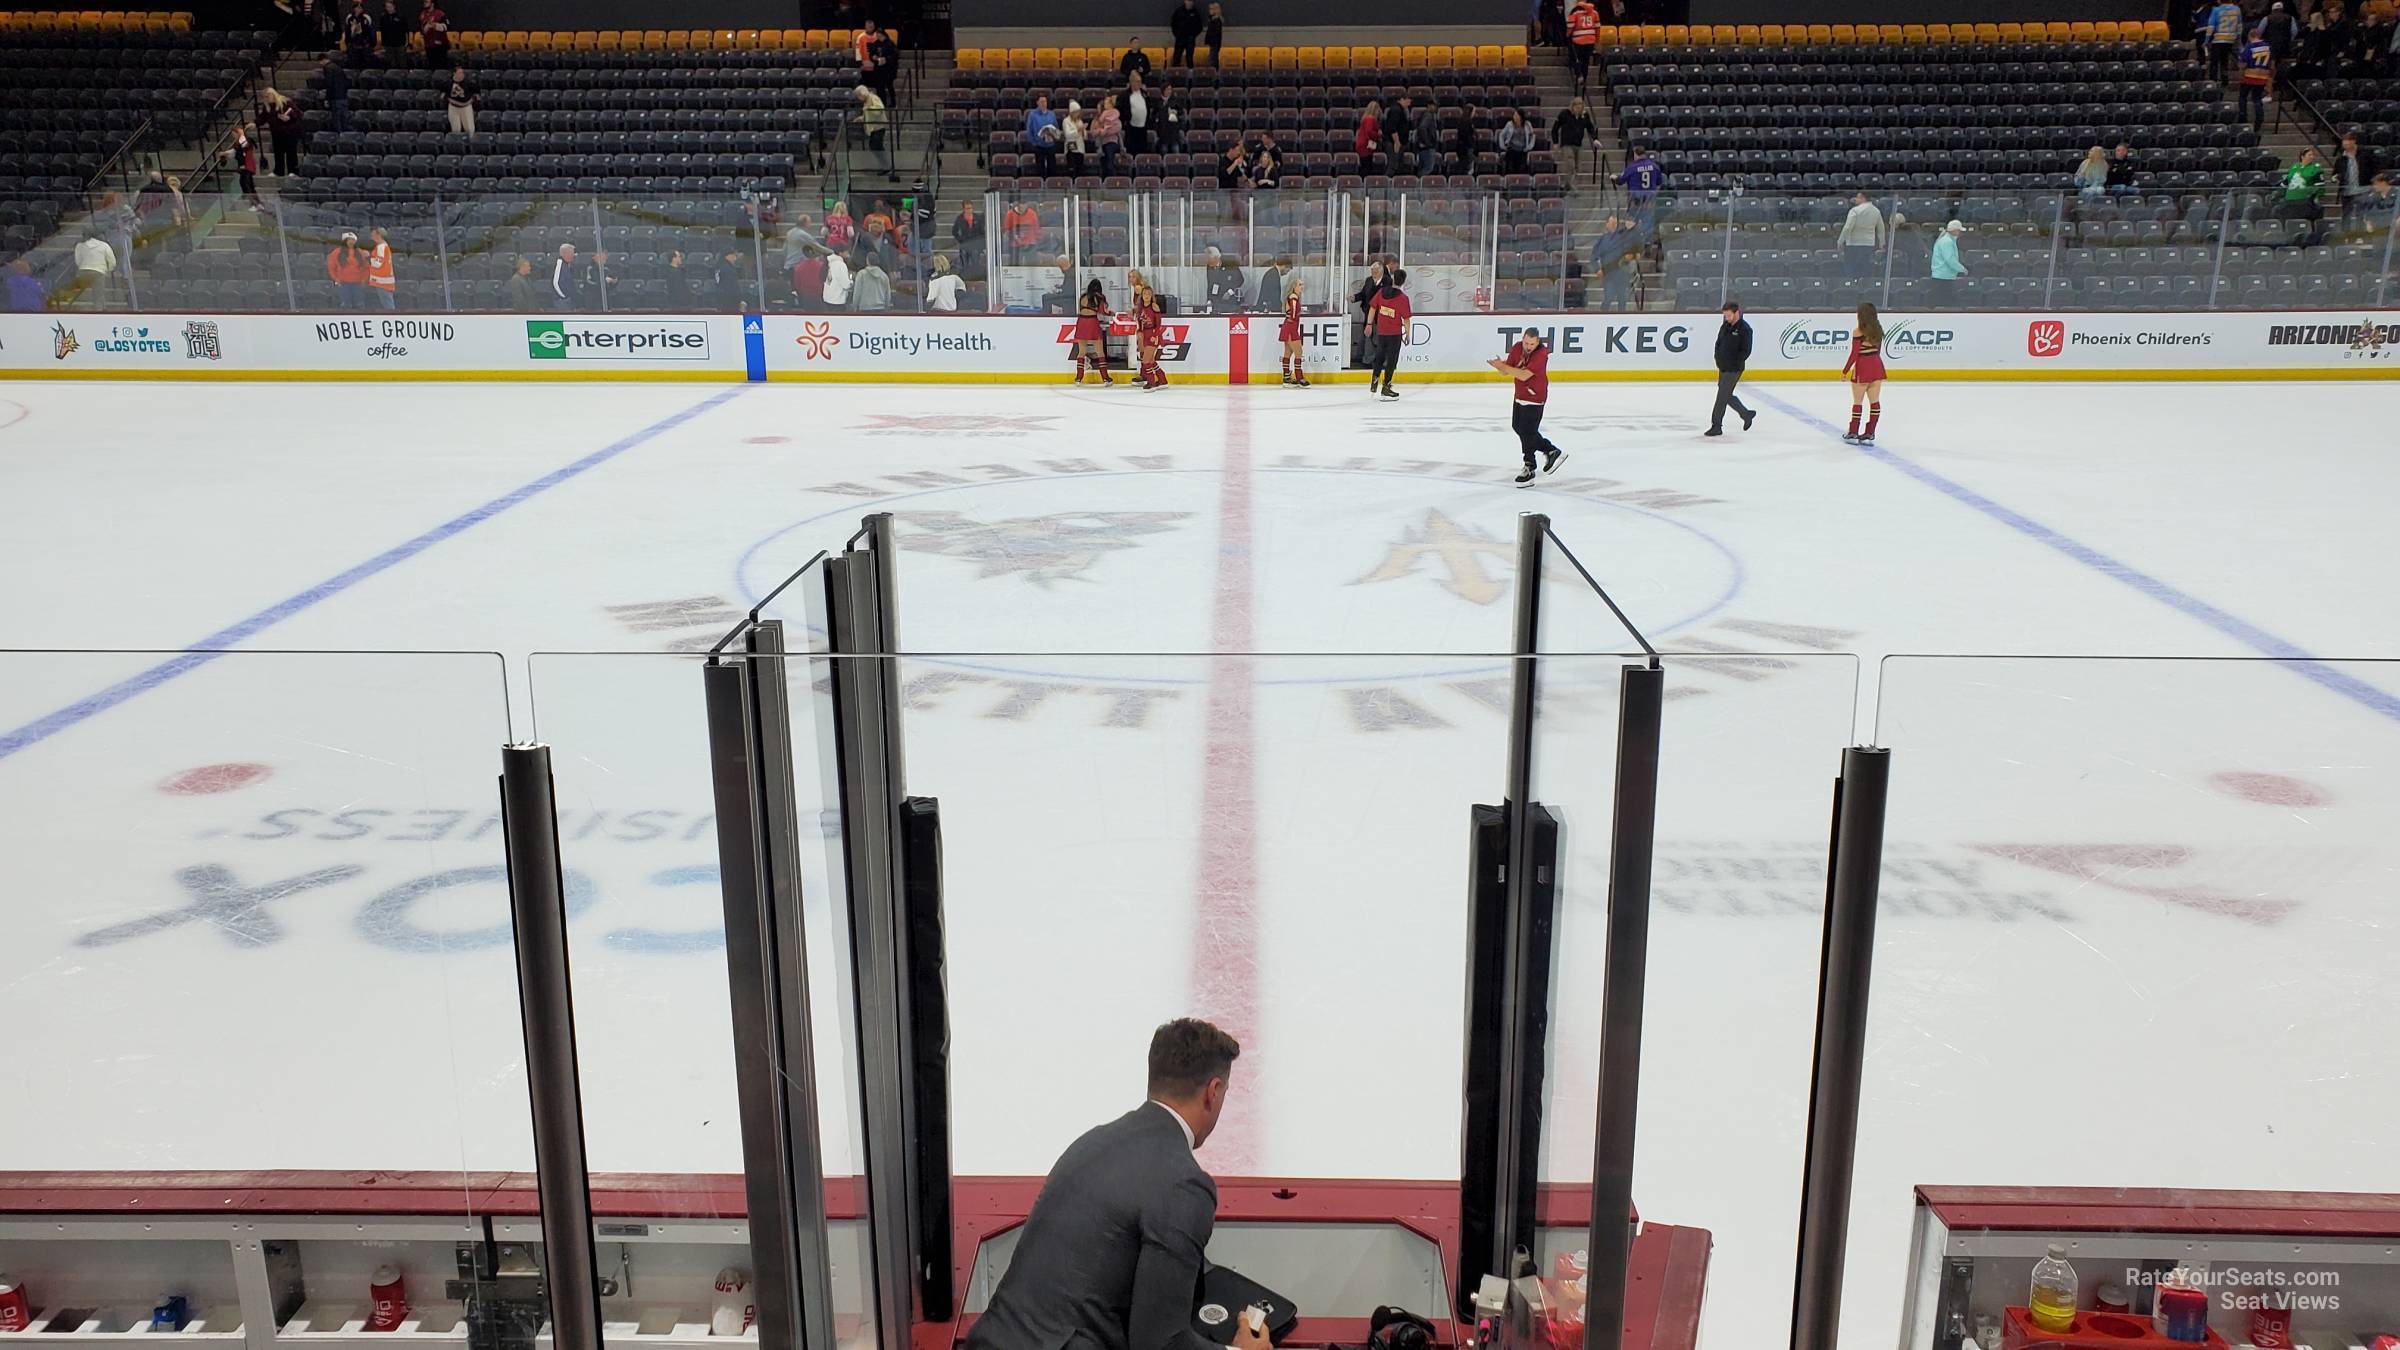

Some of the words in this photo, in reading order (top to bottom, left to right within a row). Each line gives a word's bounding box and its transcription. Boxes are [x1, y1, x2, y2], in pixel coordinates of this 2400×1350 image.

[1641, 171, 1650, 188] 9
[316, 320, 374, 342] NOBLE
[382, 320, 454, 341] GROUND
[1279, 324, 1339, 346] HE
[1605, 326, 1689, 353] KEG
[1791, 330, 1850, 345] ACP
[1895, 330, 1954, 345] ACP
[2072, 332, 2131, 345] Phoenix
[2137, 332, 2212, 345] Children's
[95, 340, 170, 352] @LOSYOTES
[530, 329, 704, 352] enterprise
[850, 332, 921, 355] Dignity
[927, 332, 992, 350] Health
[367, 343, 408, 359] coffee
